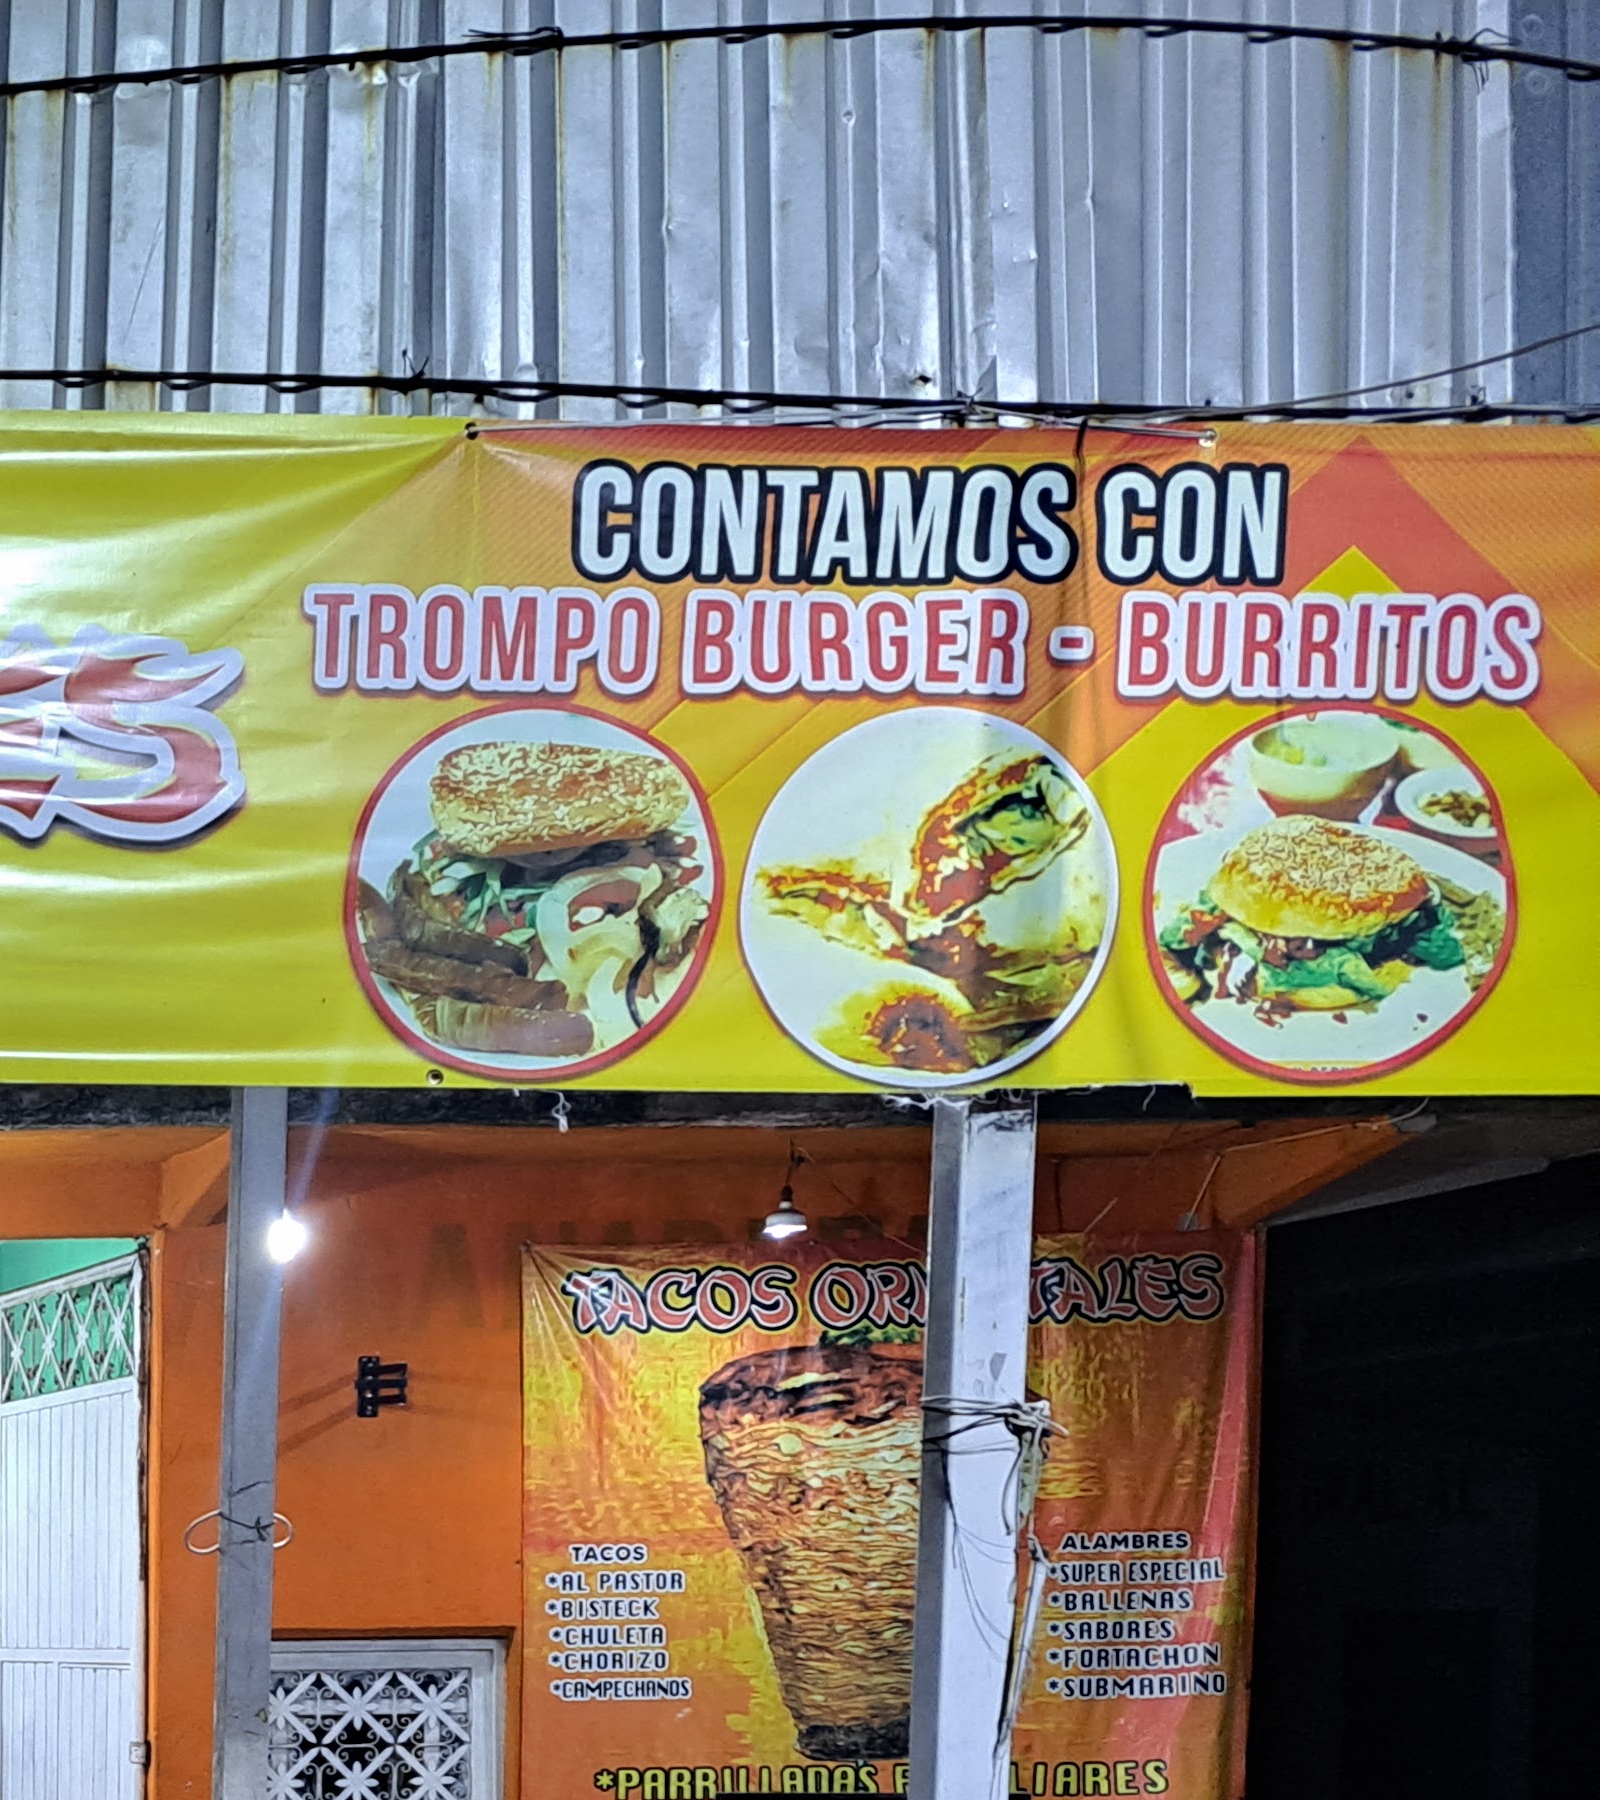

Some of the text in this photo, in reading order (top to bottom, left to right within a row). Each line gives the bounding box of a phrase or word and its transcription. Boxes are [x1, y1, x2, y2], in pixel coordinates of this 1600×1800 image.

[572, 460, 1289, 585] CONTAMOS CON
[304, 583, 660, 695] TROMPO
[683, 584, 1029, 697] BURGER
[1115, 592, 1542, 701] BURRITOS
[563, 1257, 1223, 1333] TACOS ORITALES
[1061, 1533, 1190, 1550] ALAMBRES
[570, 1545, 646, 1563] TACOS
[598, 1571, 684, 1591] PASTOR
[1059, 1560, 1225, 1584] SUPER ESPECIAL
[561, 1599, 658, 1618] BISTECK
[1064, 1590, 1192, 1611] BALLENAS
[564, 1627, 664, 1646] CHULETA
[1063, 1620, 1173, 1640] SABORES
[564, 1651, 667, 1671] CHORIZO
[1063, 1644, 1220, 1669] FORTACHON
[562, 1679, 690, 1699] CAMPECHANOS
[1063, 1673, 1226, 1698] SUBMARINO
[616, 1764, 878, 1800] PARRILLADAS
